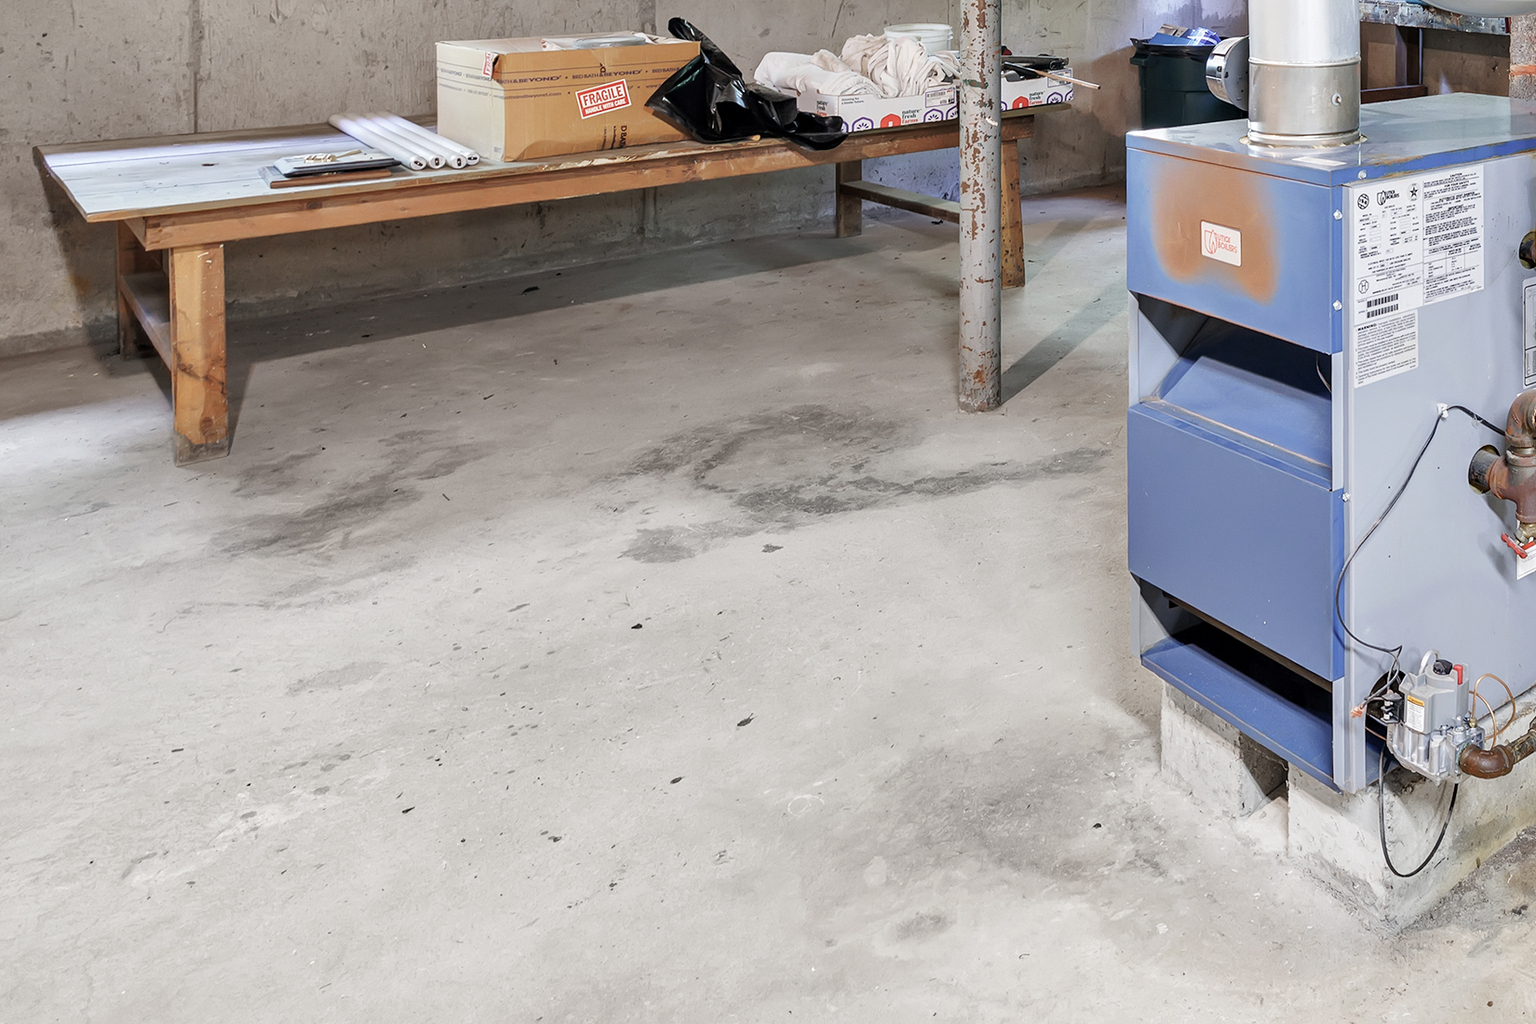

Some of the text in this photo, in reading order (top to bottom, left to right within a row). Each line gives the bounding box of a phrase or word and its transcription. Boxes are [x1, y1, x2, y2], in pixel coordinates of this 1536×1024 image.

[583, 86, 624, 107] FRAGILE
[585, 98, 627, 115] HANDLE WITH CARE
[1218, 242, 1237, 254] BOILERS
